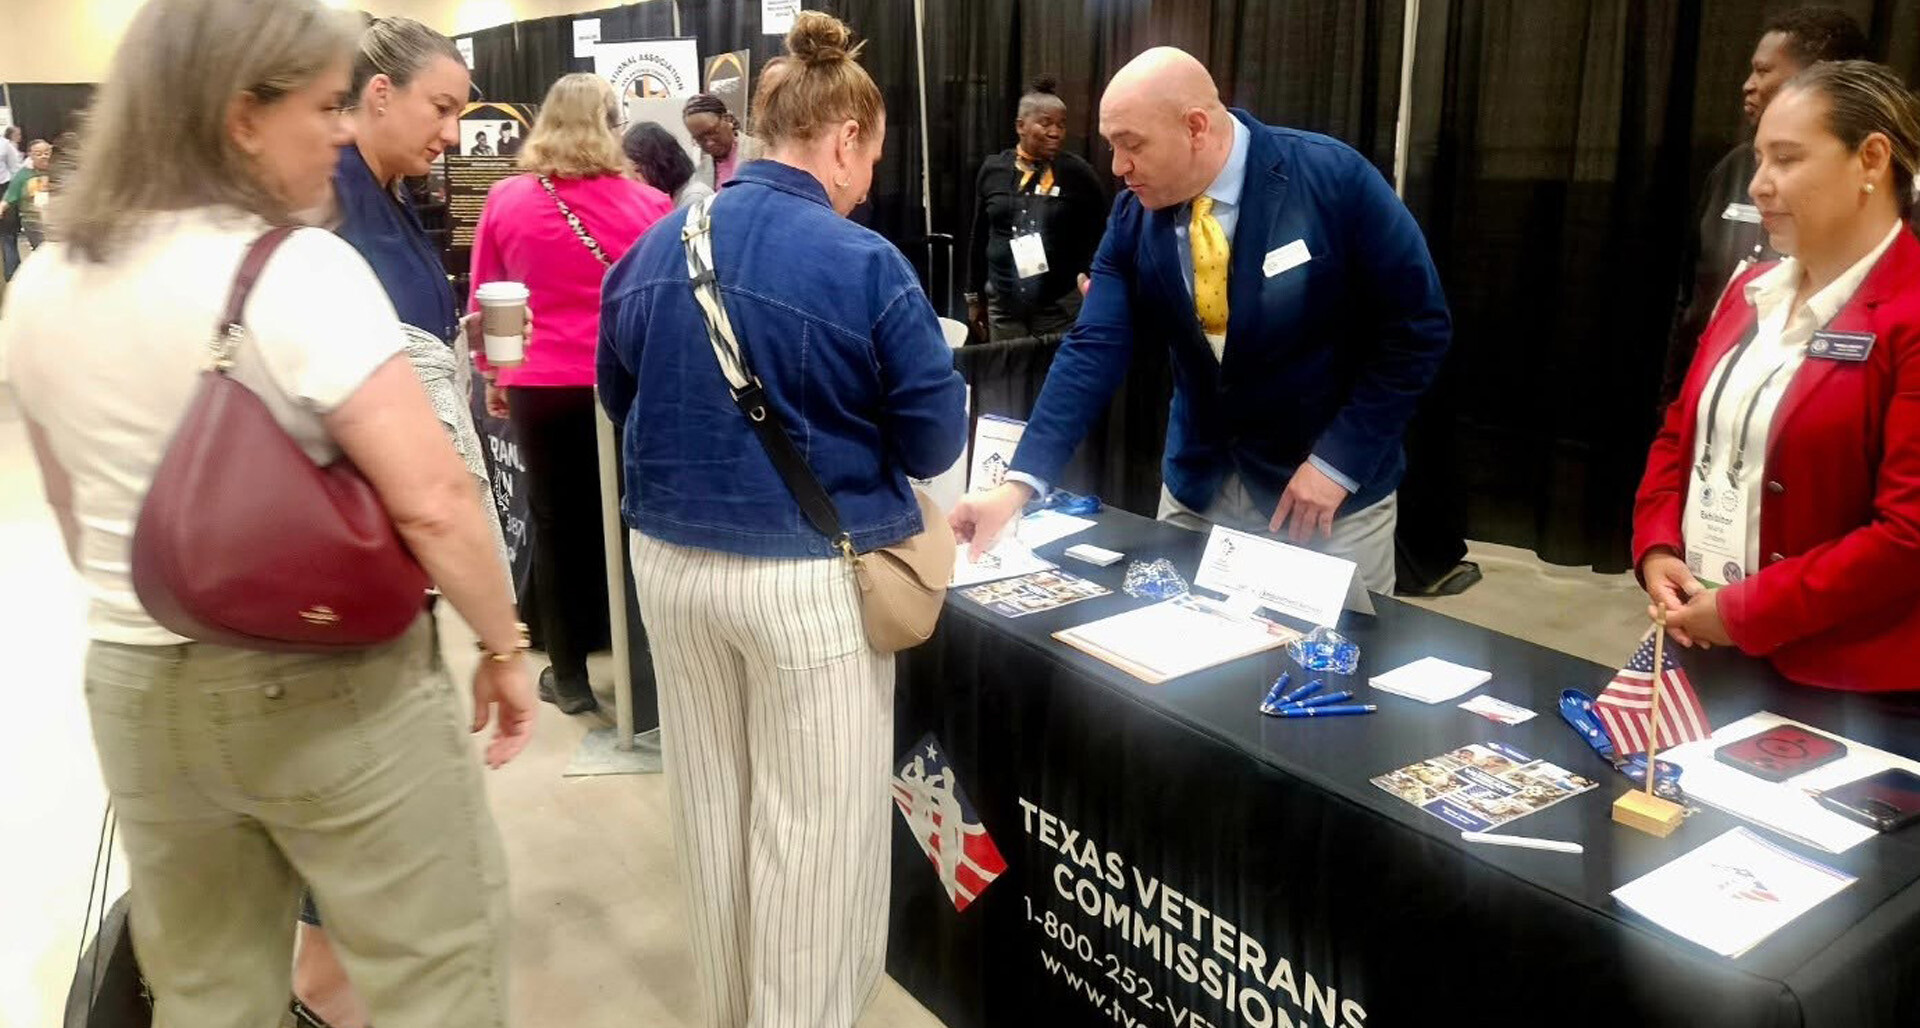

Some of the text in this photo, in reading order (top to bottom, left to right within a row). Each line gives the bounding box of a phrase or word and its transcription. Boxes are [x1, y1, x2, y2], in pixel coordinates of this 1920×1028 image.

[610, 55, 637, 84] ATIONAL
[639, 53, 684, 90] ASSOCIATION
[488, 434, 526, 472] RAN
[1019, 797, 1367, 1028] TEXAS VETERANS
[1024, 895, 1216, 1028] 1-800-252-VE
[1041, 950, 1148, 1028] www.tv
